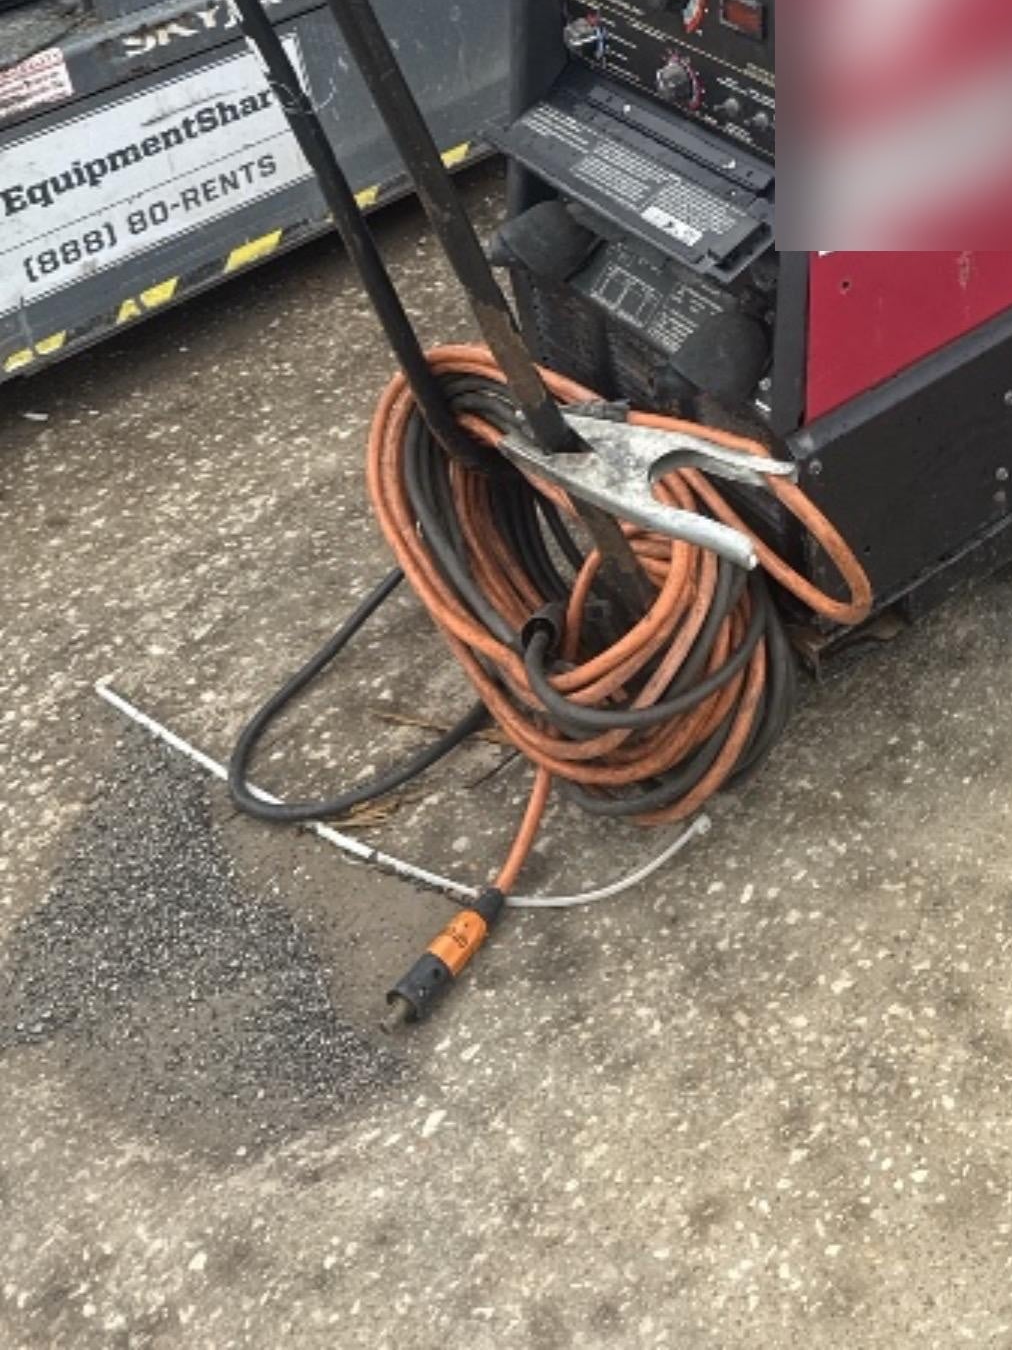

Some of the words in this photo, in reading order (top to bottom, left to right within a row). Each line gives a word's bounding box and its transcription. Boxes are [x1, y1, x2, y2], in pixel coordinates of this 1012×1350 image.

[2, 88, 278, 216] EquipmentShar
[23, 221, 118, 282] (888)
[127, 154, 277, 235] 80-RENTS
